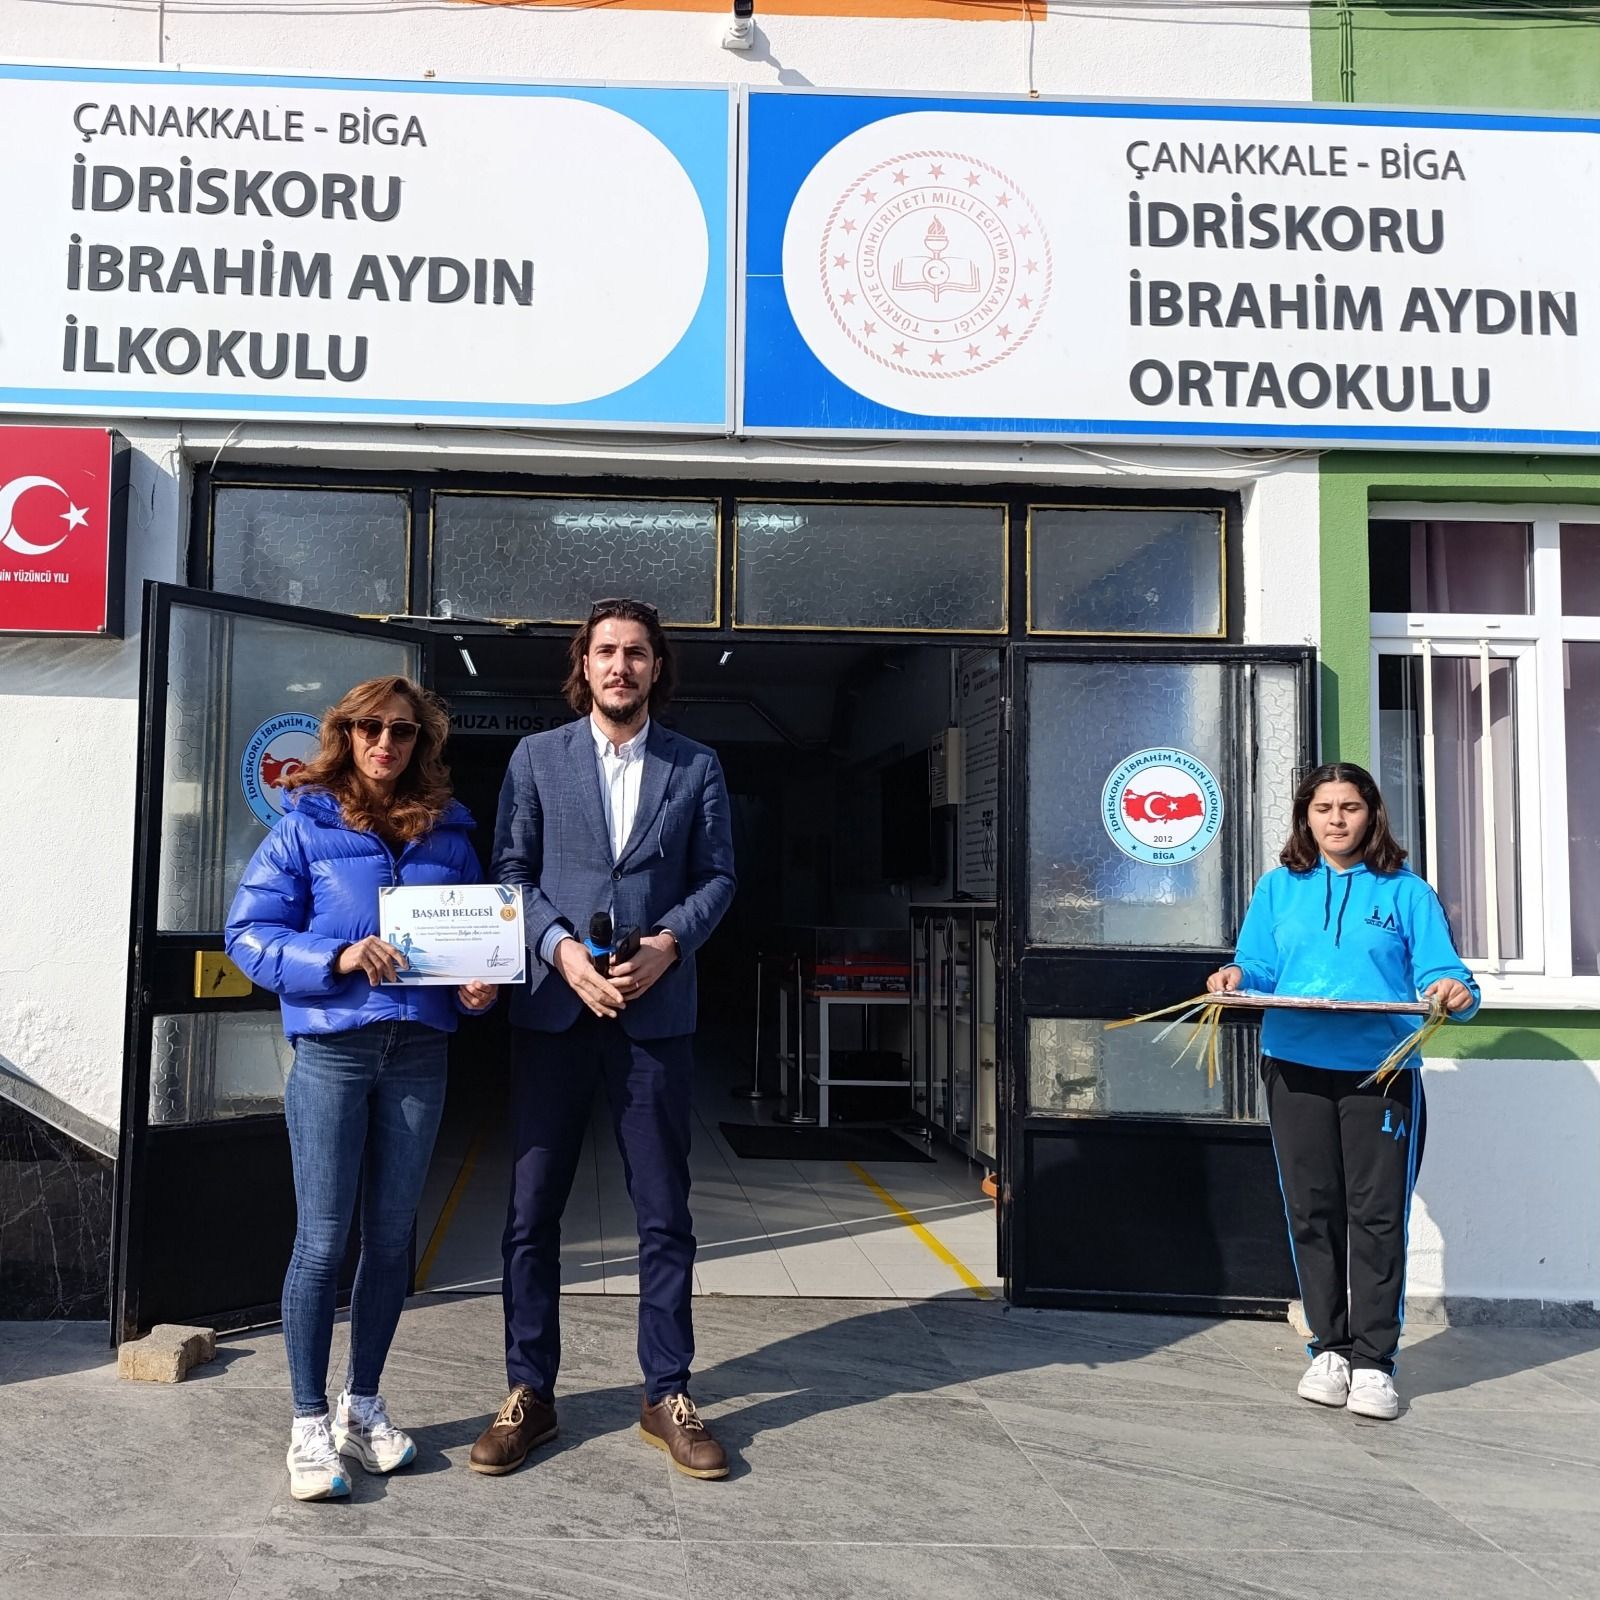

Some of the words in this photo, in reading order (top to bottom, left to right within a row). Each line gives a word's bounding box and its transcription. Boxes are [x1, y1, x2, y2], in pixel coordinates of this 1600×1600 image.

[73, 102, 304, 145] ÇANAKKALE
[339, 106, 427, 147] BİGA
[71, 152, 403, 223] İDRİSKORU
[1126, 140, 1348, 181] ÇANAKKALE
[1381, 142, 1466, 181] BİGA
[931, 192, 976, 213] MİLLİ
[1128, 190, 1444, 255] İDRİSKORU
[863, 192, 927, 279] CUMHURİYETİ
[975, 209, 1010, 261] EĞİTİM
[66, 233, 332, 300] İBRAHİM
[347, 253, 535, 307] AYDIN
[867, 283, 920, 335] TÜRKİYE
[953, 265, 1010, 335] BAKANLIĞI
[1128, 268, 1383, 332] İBRAHİM
[1399, 286, 1579, 338] AYDIN
[62, 313, 369, 384] İLKOKULU
[1129, 358, 1491, 415] ORTAOKULU
[13, 569, 51, 583] YÜZÜNCÜ
[53, 572, 69, 583] YILI
[243, 737, 263, 800] İDRİSKORU
[261, 716, 303, 740] İBRAHİM
[1106, 772, 1126, 833] İDRİSKORU
[1126, 752, 1172, 775] İBRAHİM
[1174, 756, 1207, 780] AYDIN
[1203, 779, 1218, 834] İLKOKULU
[1152, 851, 1175, 860] BİGA
[1153, 835, 1173, 843] 2012
[412, 908, 450, 919] BAŞARI
[452, 906, 493, 917] BELGESİ
[505, 909, 512, 918] 3
